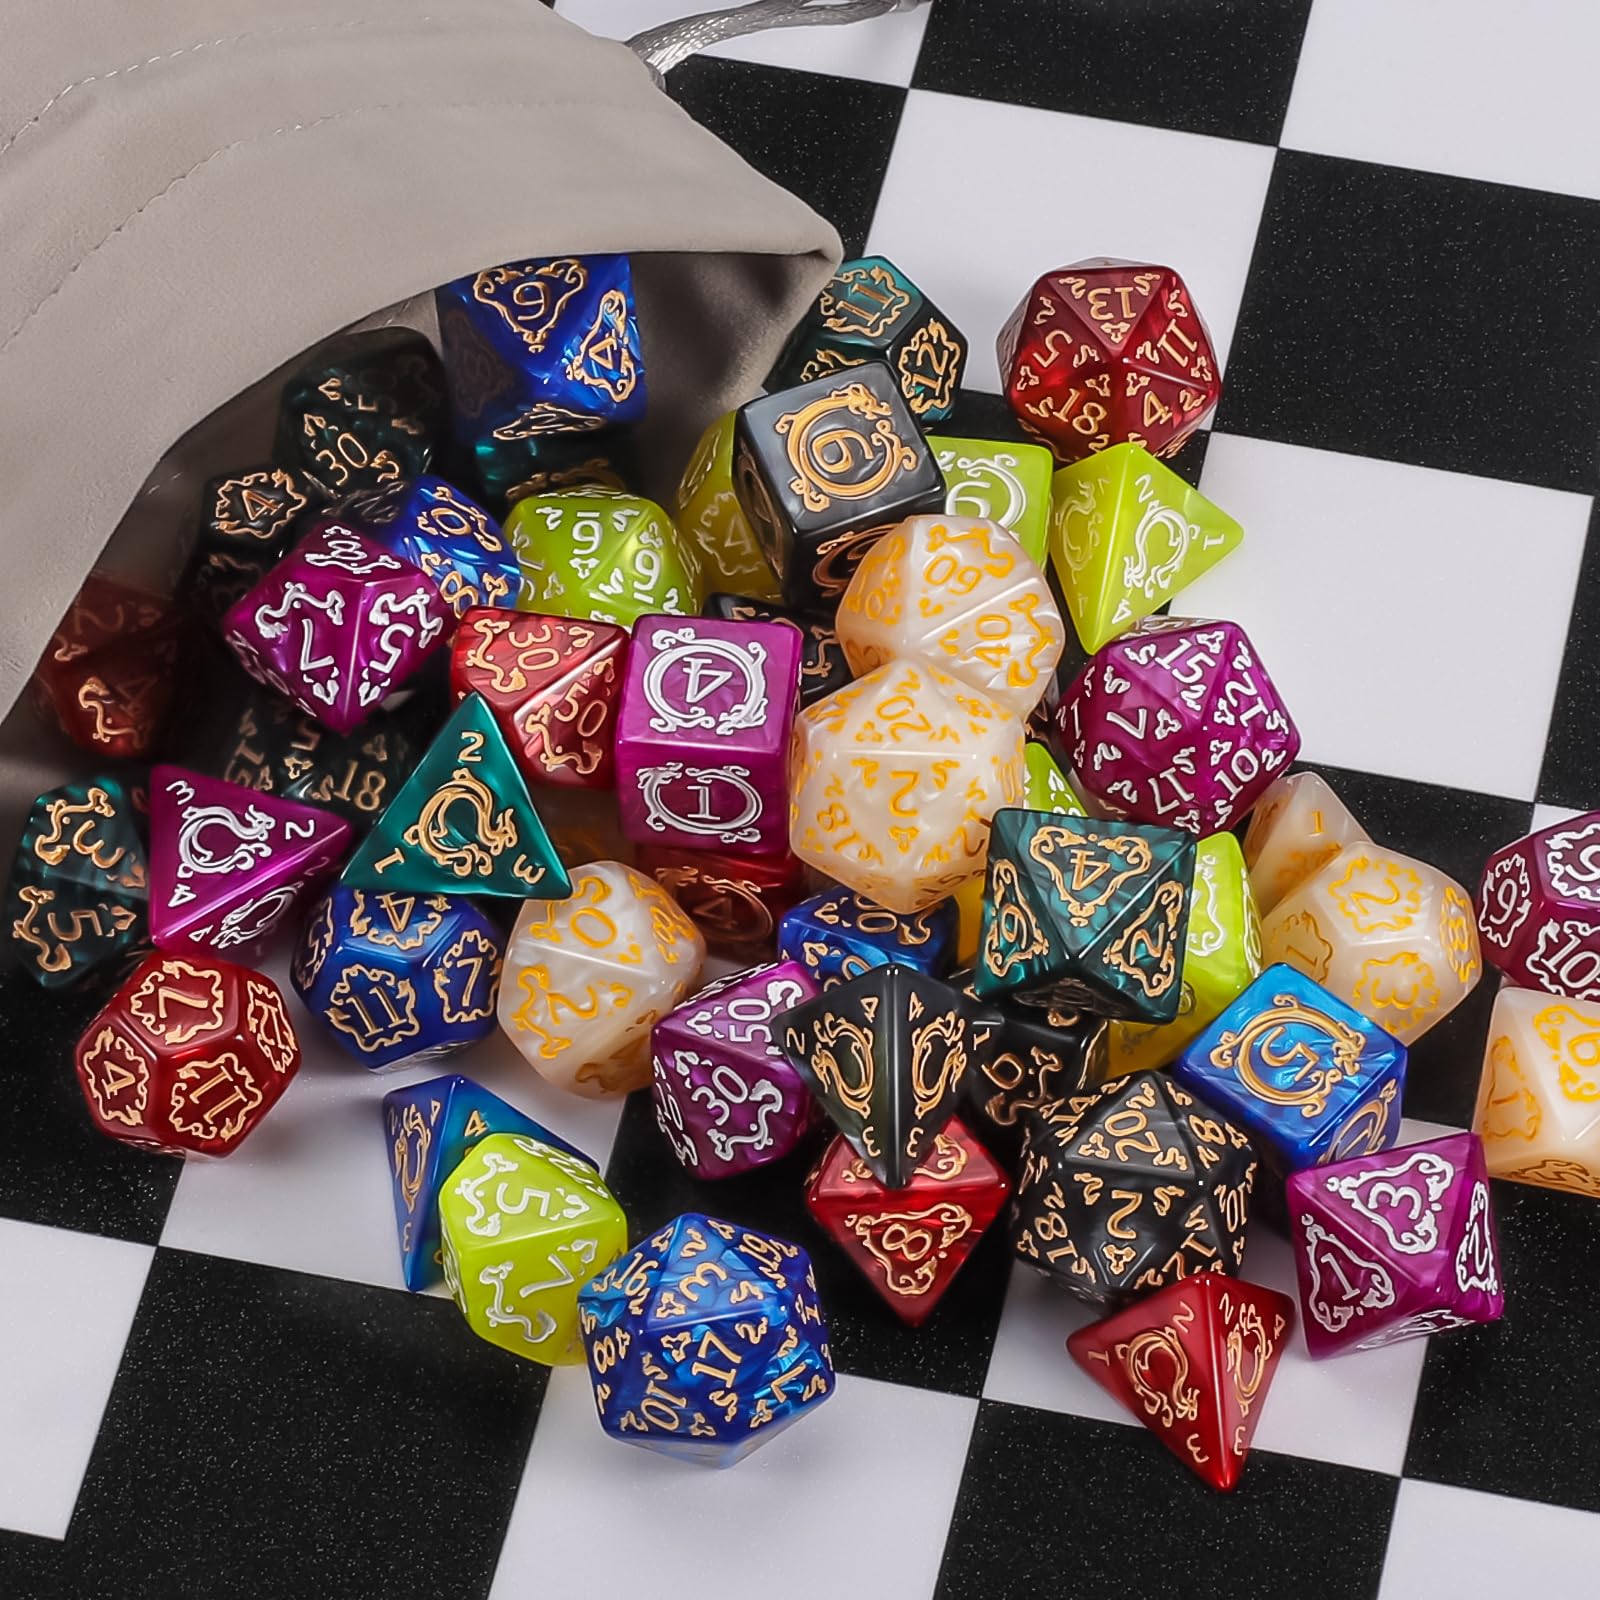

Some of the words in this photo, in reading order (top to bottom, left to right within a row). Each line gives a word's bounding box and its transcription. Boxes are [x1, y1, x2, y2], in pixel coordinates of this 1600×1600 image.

[1086, 286, 1138, 321] 13
[1156, 318, 1199, 368] 11
[1052, 388, 1108, 436] 18
[1143, 390, 1173, 428] 4
[315, 432, 368, 486] 30
[242, 488, 283, 521] 4
[1134, 473, 1156, 503] 2
[1111, 600, 1132, 625] 4
[508, 625, 561, 671] 30
[974, 613, 1012, 669] 40
[1155, 638, 1216, 684] 15
[682, 656, 734, 705] 4
[1225, 671, 1268, 728] 12
[554, 683, 608, 738] 50
[1106, 708, 1148, 740] 7
[458, 731, 486, 763] 2
[165, 780, 196, 805] 3
[333, 760, 388, 811] 18
[888, 769, 920, 817] 2
[1148, 768, 1195, 815] 17
[1214, 748, 1259, 801] 10
[687, 785, 721, 821] 1
[1312, 810, 1325, 834] 1
[73, 820, 125, 869] 3
[284, 818, 315, 840] 2
[374, 847, 406, 874] 1
[511, 853, 546, 884] 3
[1070, 848, 1111, 891] 4
[167, 883, 197, 908] 4
[375, 892, 416, 933] 4
[1350, 876, 1402, 916] 2
[1489, 878, 1518, 925] 9
[570, 906, 618, 949] 0
[456, 956, 484, 1007] 7
[1540, 934, 1600, 989] 10
[157, 986, 209, 1019] 7
[345, 986, 408, 1038] 11
[546, 985, 598, 1025] 2
[908, 991, 925, 1022] 4
[1370, 977, 1421, 1010] 3
[727, 997, 772, 1043] 50
[786, 1027, 805, 1055] 2
[1260, 1025, 1320, 1083] 5
[101, 1060, 137, 1100] 4
[189, 1065, 248, 1125] 11
[690, 1065, 749, 1127] 30
[463, 1109, 490, 1137] 4
[862, 1126, 880, 1158] 3
[905, 1127, 924, 1158] 3
[1104, 1109, 1161, 1163] 20
[1187, 1114, 1227, 1146] 8
[495, 1182, 550, 1217] 5
[1106, 1188, 1144, 1240] 2
[1367, 1181, 1424, 1220] 3
[881, 1222, 933, 1262] 8
[1034, 1211, 1080, 1264] 18
[519, 1253, 575, 1298] 7
[612, 1252, 660, 1297] 16
[678, 1262, 728, 1303] 3
[1319, 1252, 1361, 1301] 1
[1172, 1300, 1196, 1335] 2
[1218, 1292, 1235, 1326] 2
[593, 1335, 616, 1375] 8
[692, 1331, 743, 1389] 17
[770, 1361, 808, 1404] 7
[640, 1380, 688, 1432] 10
[1186, 1432, 1210, 1465] 3
[1233, 1425, 1247, 1457] 3
